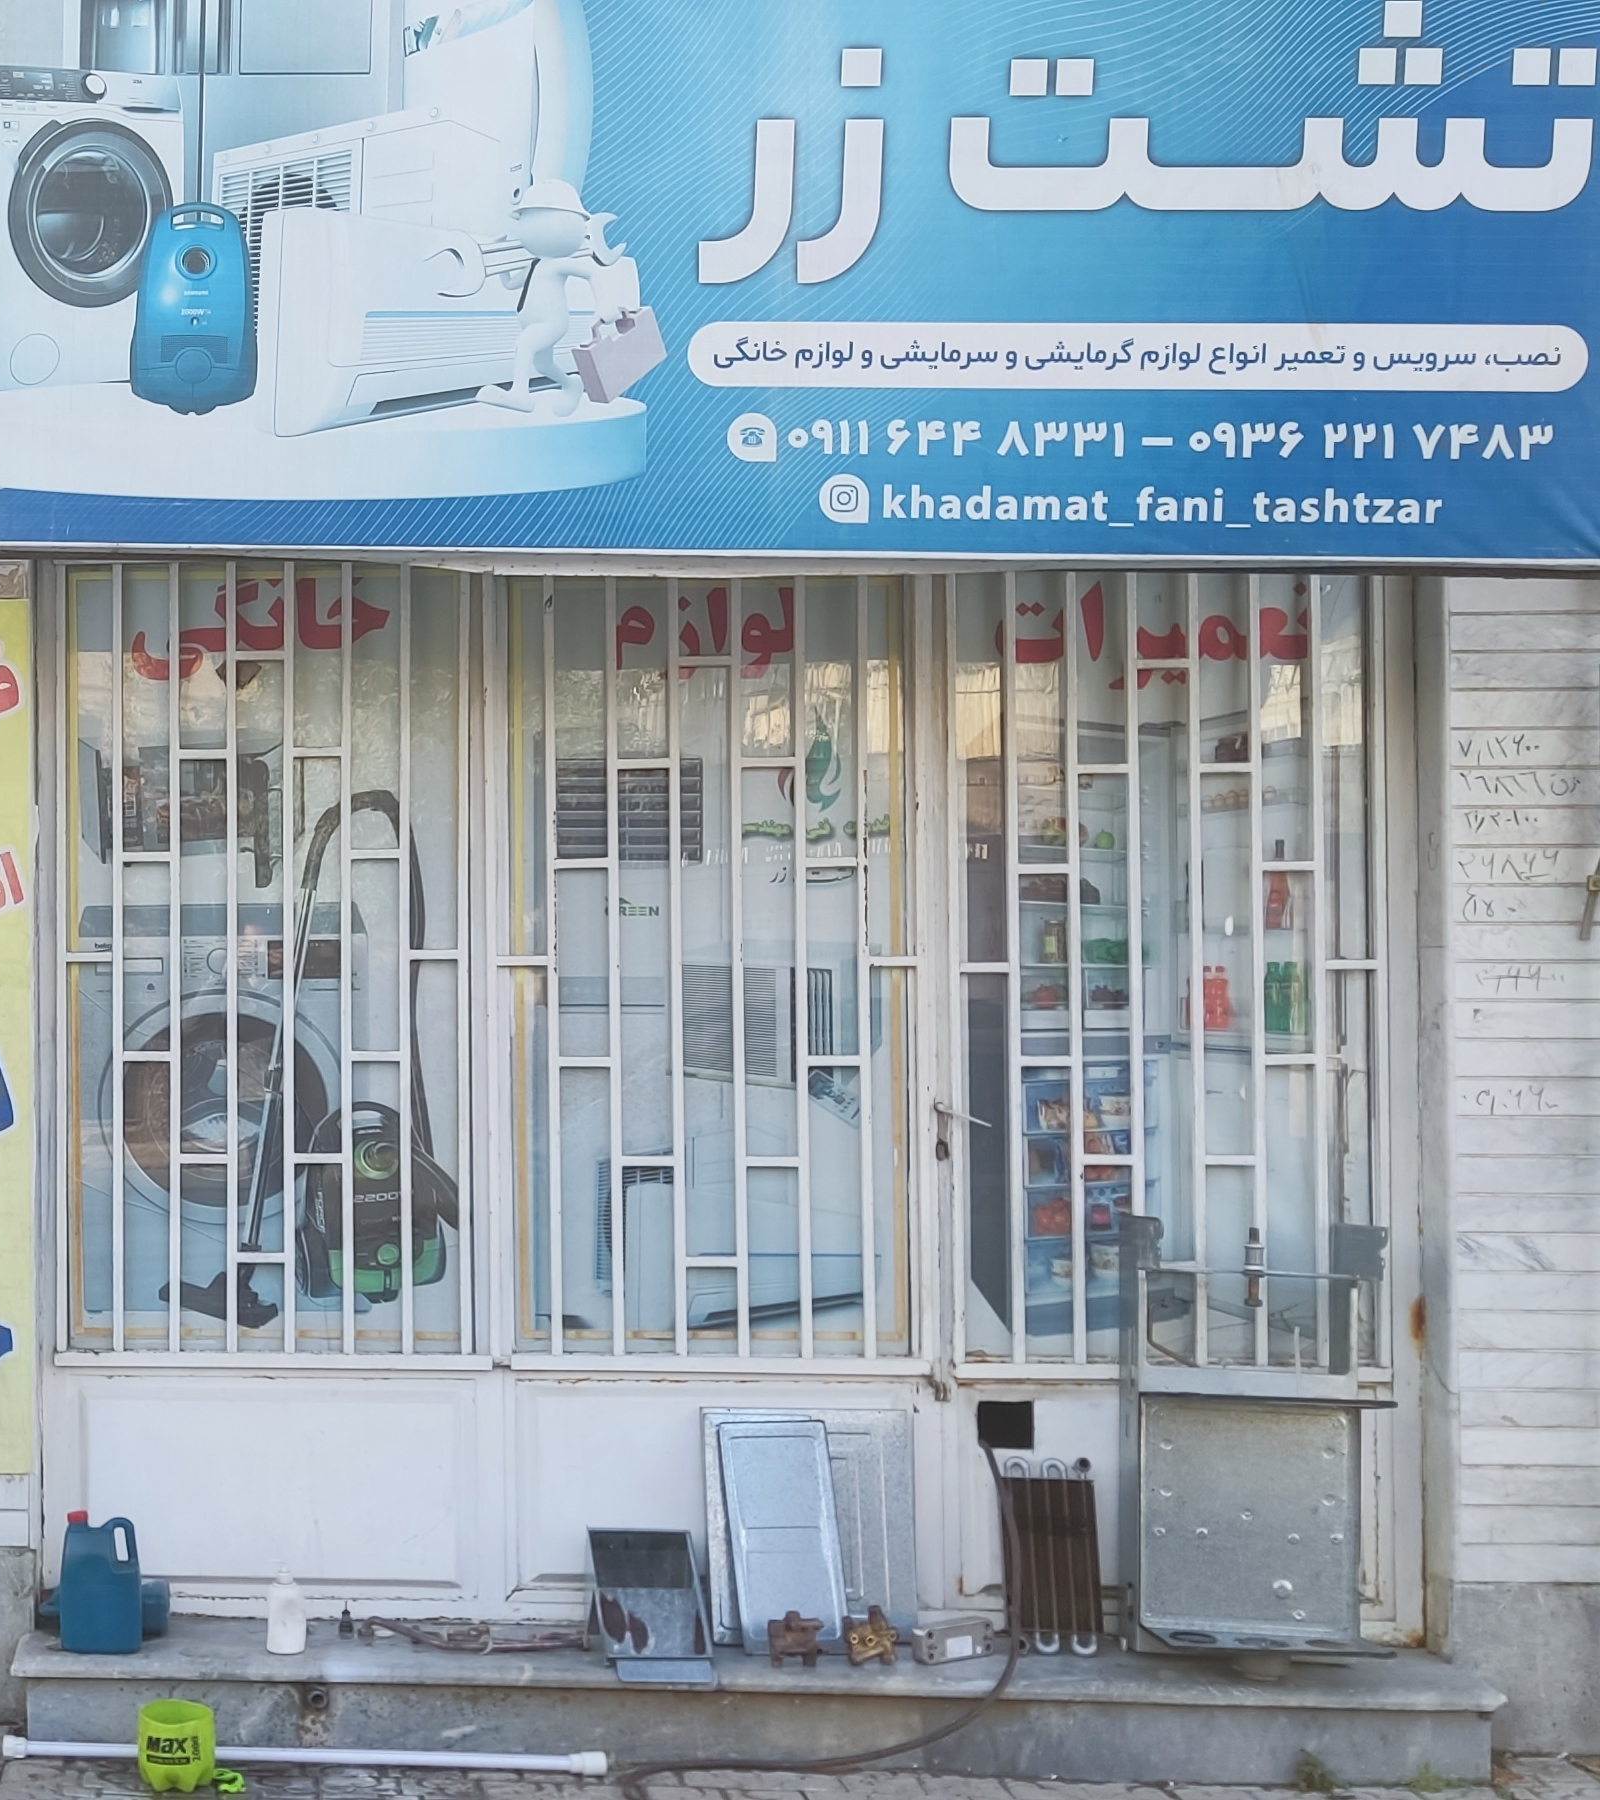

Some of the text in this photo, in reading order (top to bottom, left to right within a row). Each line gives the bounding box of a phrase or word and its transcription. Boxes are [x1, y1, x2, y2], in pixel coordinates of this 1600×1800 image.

[698, 0, 1598, 284] تشت زر
[713, 336, 1562, 375] نصب، سرویس و تعمیر انواع لوازم گرمایشی و سرمایشی و لوازم خانگی
[788, 419, 869, 456] ۰۹۱۱
[887, 419, 982, 456] ۶۴۴
[997, 421, 1125, 458] ۸۳۳۱
[1189, 421, 1305, 458] ۰۹۳۶
[1324, 423, 1395, 459] ۲۲۱
[1413, 424, 1554, 460] ۷۴۸۳
[883, 484, 1443, 528] khadamat_fani_tashtzar
[131, 577, 390, 681] خانگی
[616, 587, 794, 680] لوازم
[604, 905, 659, 917] REEN
